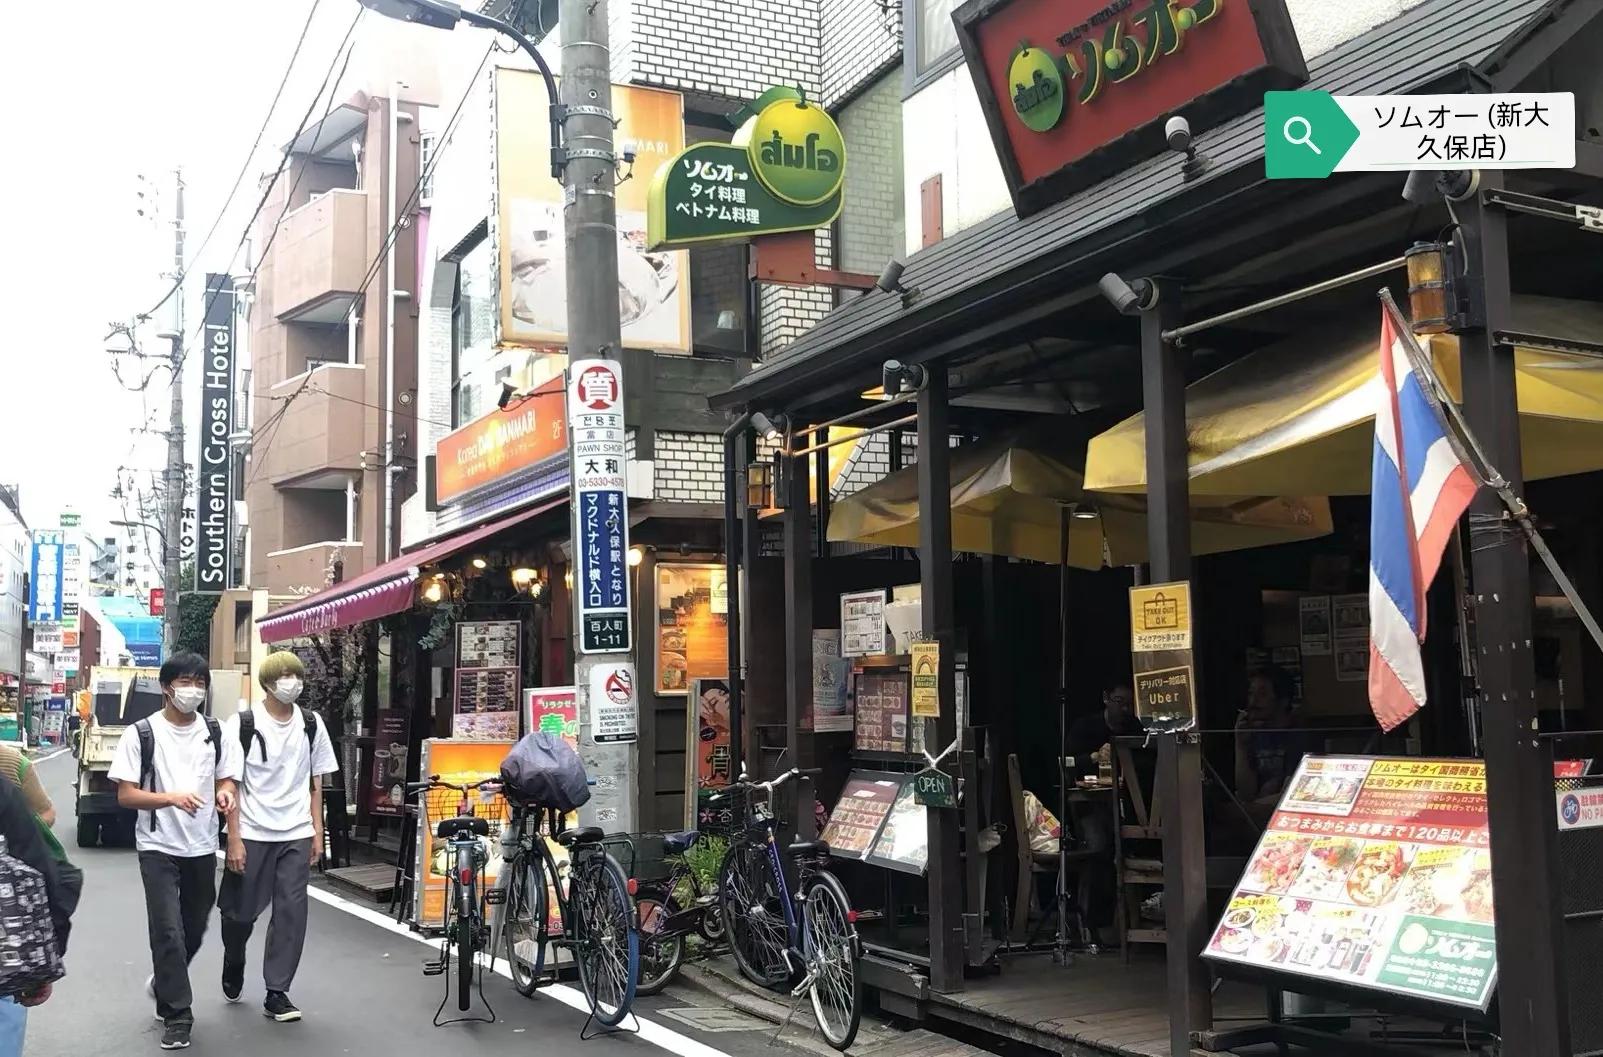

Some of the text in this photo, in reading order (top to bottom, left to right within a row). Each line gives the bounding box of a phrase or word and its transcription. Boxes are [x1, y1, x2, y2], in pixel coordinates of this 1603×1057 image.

[683, 159, 748, 184] ソムオー
[689, 182, 747, 204] タイ料理
[675, 201, 761, 225] ベトナム料理
[202, 323, 230, 583] Southern Cross Hotel
[577, 443, 623, 453] PAWN SHOP
[585, 458, 618, 474] 大和
[586, 493, 602, 606] マクドナルド横入口
[607, 493, 623, 605] 新大久保駅となり
[1146, 608, 1162, 616] TAKE
[590, 620, 623, 632] 百人町
[1155, 616, 1167, 625] OK
[593, 634, 621, 645] 1-11
[1149, 691, 1180, 705] Uber
[917, 776, 946, 793] OPEN
